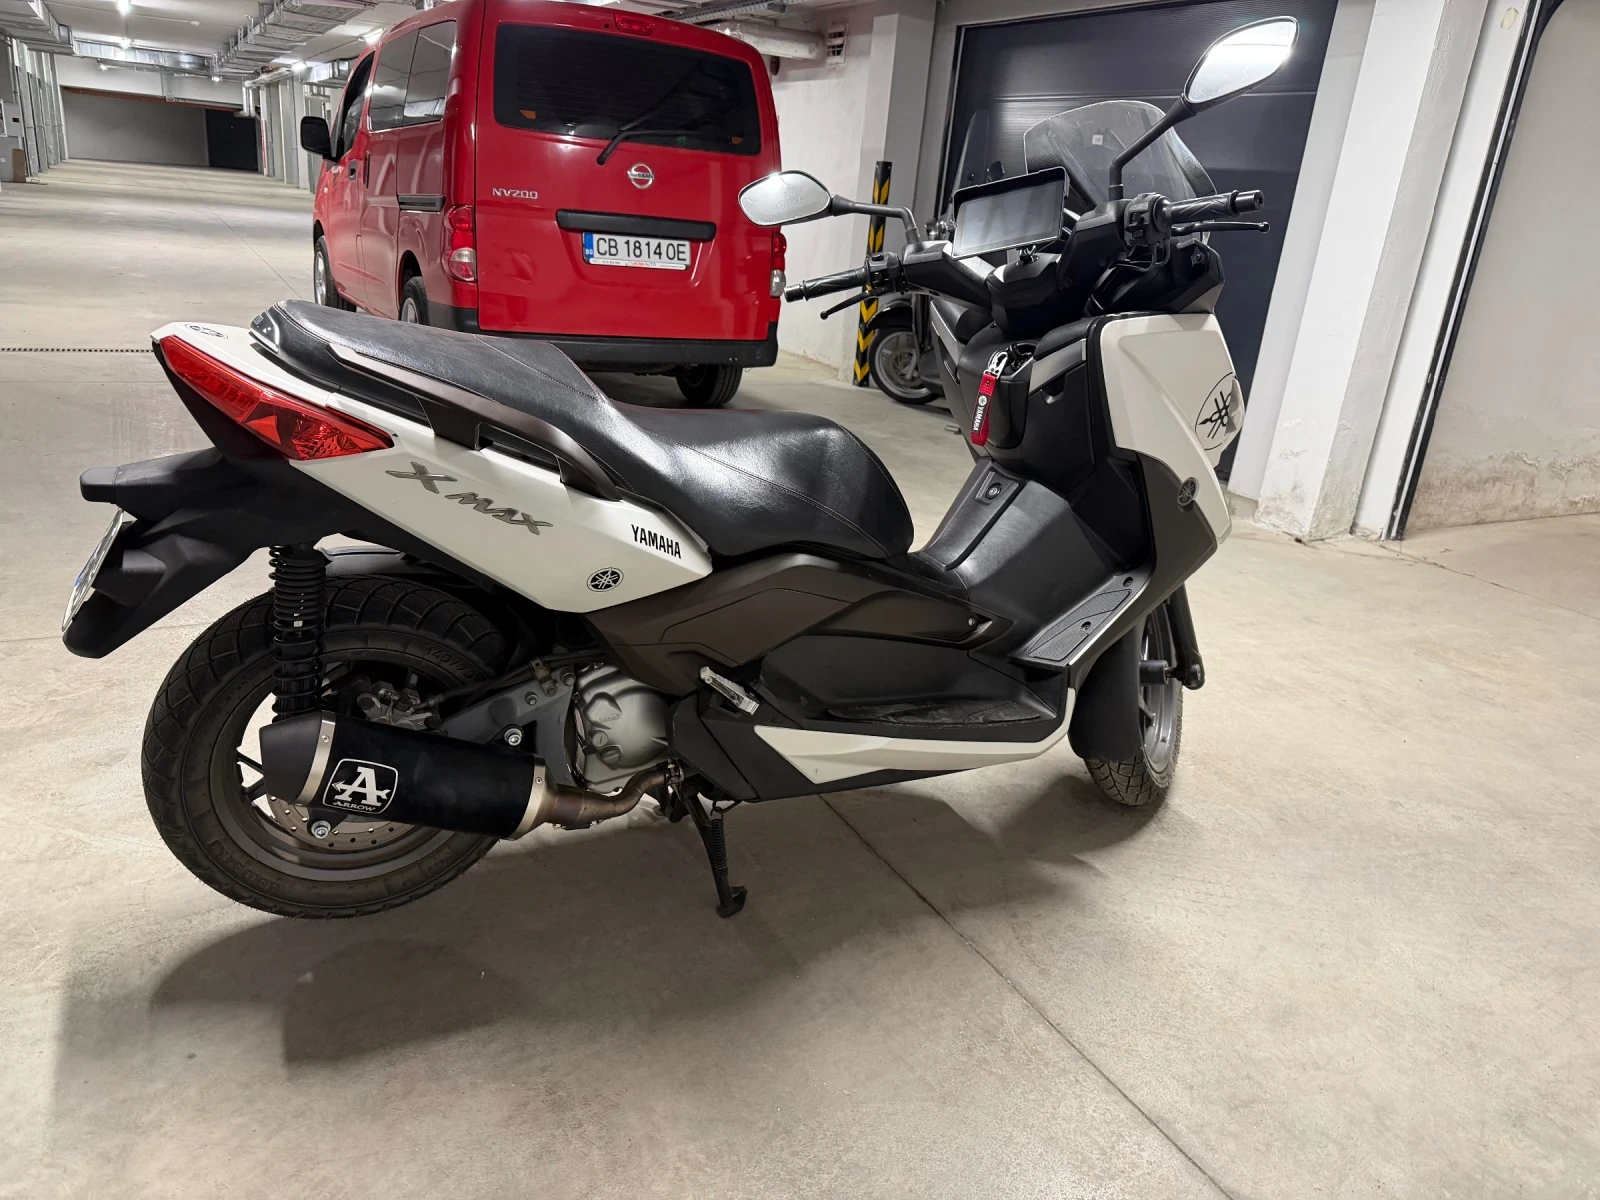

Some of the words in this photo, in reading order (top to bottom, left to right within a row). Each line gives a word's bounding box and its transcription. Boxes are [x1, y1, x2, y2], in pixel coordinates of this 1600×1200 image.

[492, 187, 539, 199] NV200
[596, 237, 619, 257] CB
[624, 239, 662, 260] 1814
[973, 407, 984, 431] YAMAHA
[631, 524, 682, 559] YAMAHA
[332, 801, 376, 812] ARROW
